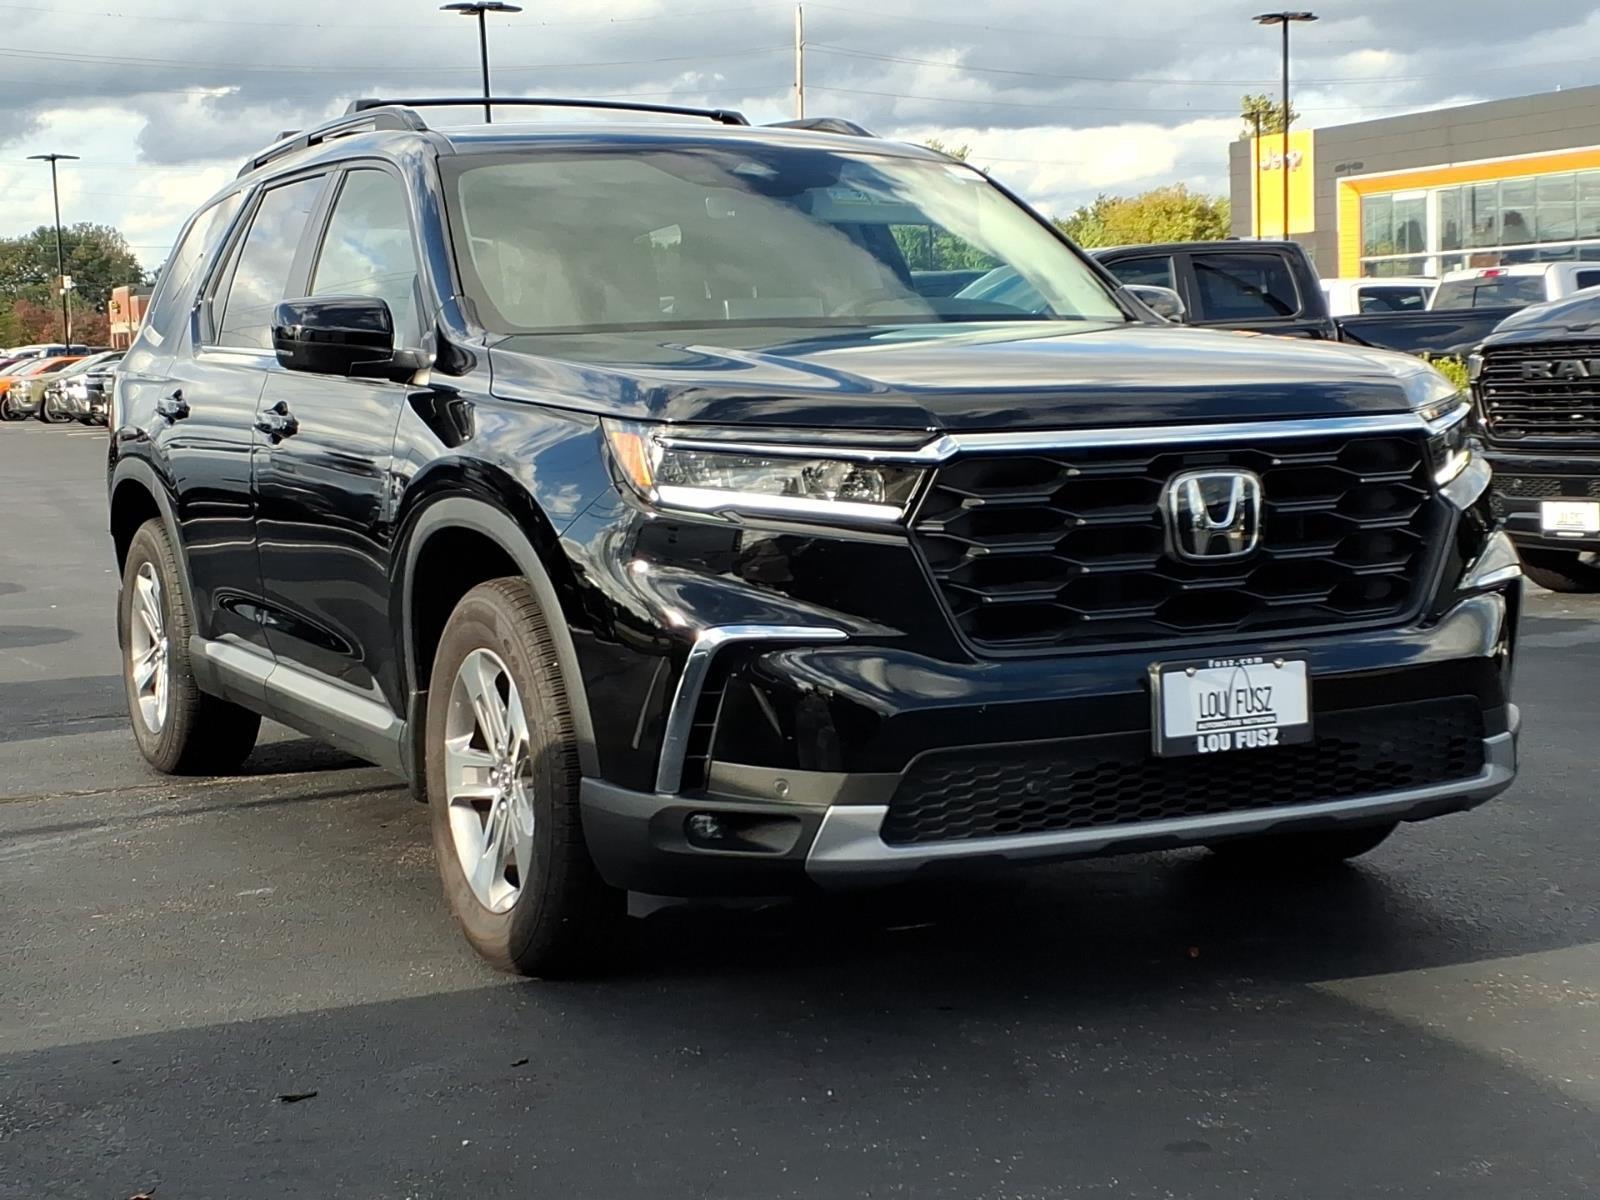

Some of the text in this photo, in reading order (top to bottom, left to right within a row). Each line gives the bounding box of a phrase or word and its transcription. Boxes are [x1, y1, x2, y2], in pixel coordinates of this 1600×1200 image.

[1200, 686, 1272, 718] LOU FUSZ
[1197, 728, 1279, 753] LOU FUSZ
